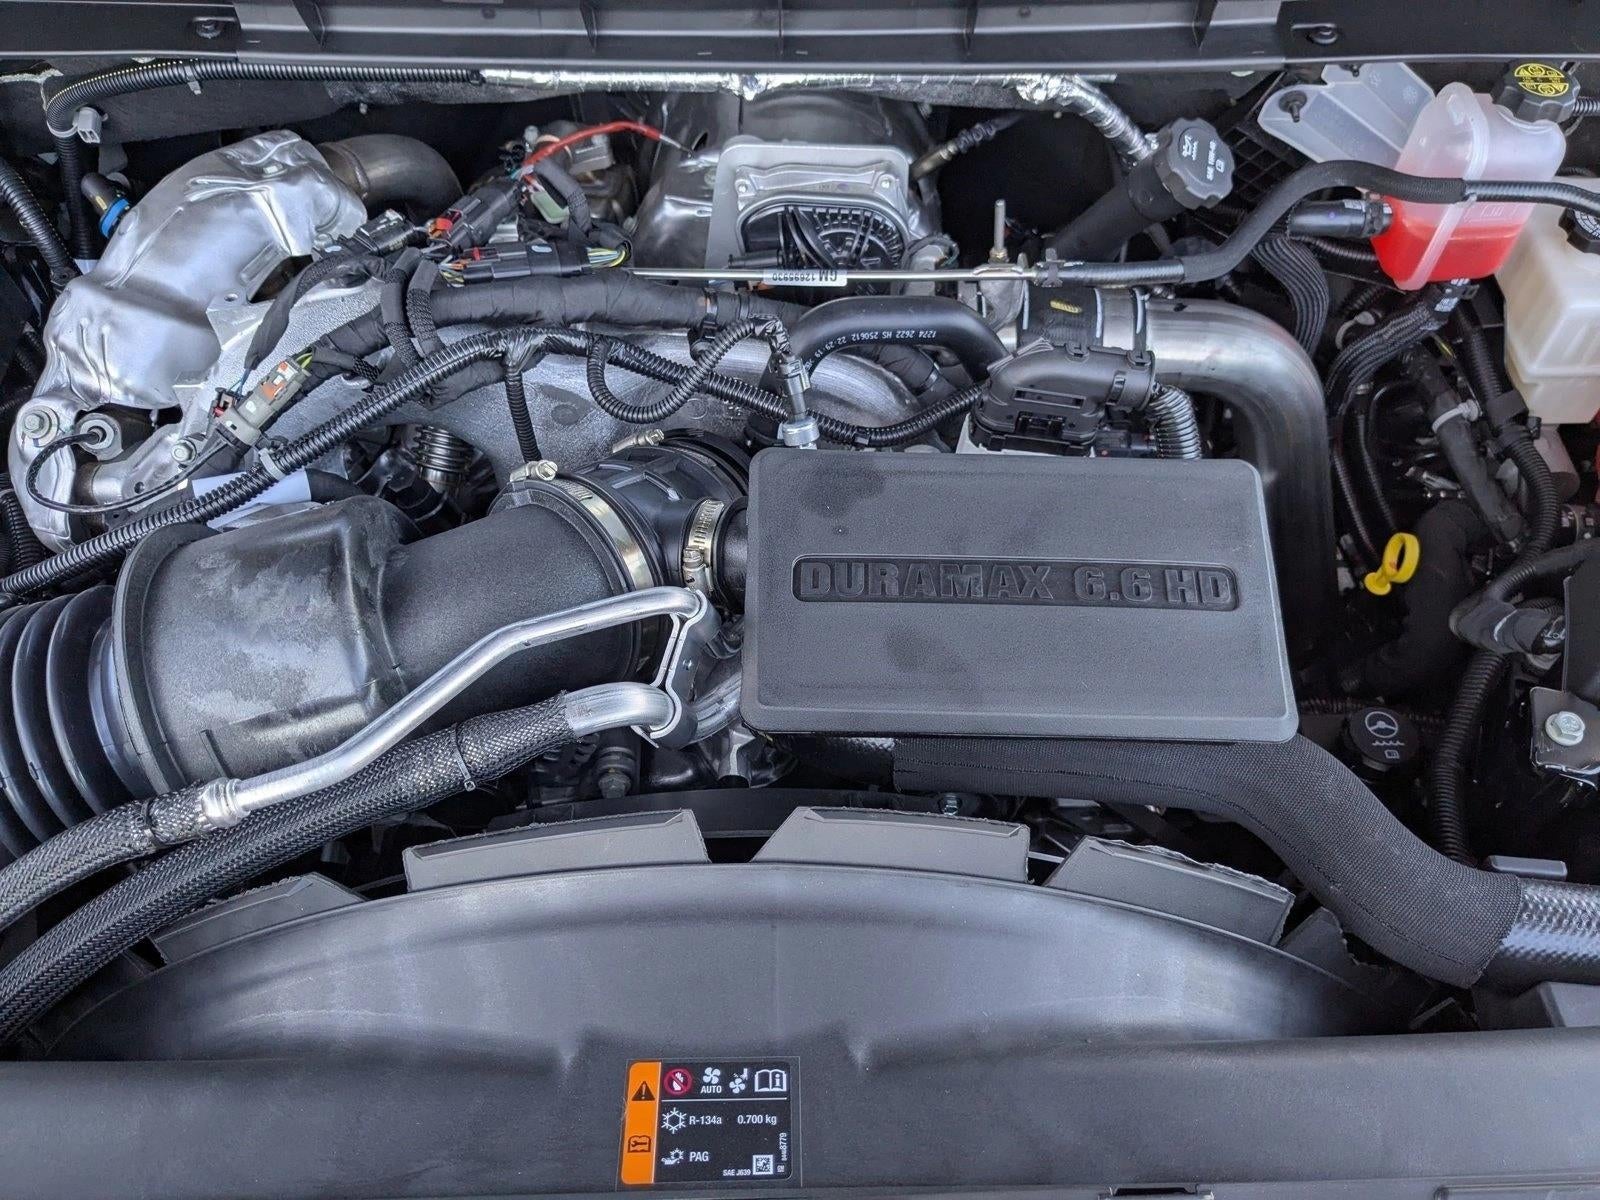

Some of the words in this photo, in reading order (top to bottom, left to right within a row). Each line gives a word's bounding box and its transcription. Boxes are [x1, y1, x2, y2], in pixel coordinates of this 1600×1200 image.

[818, 270, 837, 282] GM
[851, 331, 879, 341] 250612
[800, 561, 1054, 601] DURAMAX
[1073, 566, 1153, 602] 6.6
[1165, 568, 1232, 604] HD
[700, 1085, 722, 1094] AUTO
[689, 1115, 722, 1125] R-134a
[737, 1114, 764, 1124] 0.700
[765, 1114, 777, 1126] kg
[689, 1151, 710, 1162] PAG
[723, 1169, 736, 1177] SAE
[736, 1168, 752, 1176] J639
